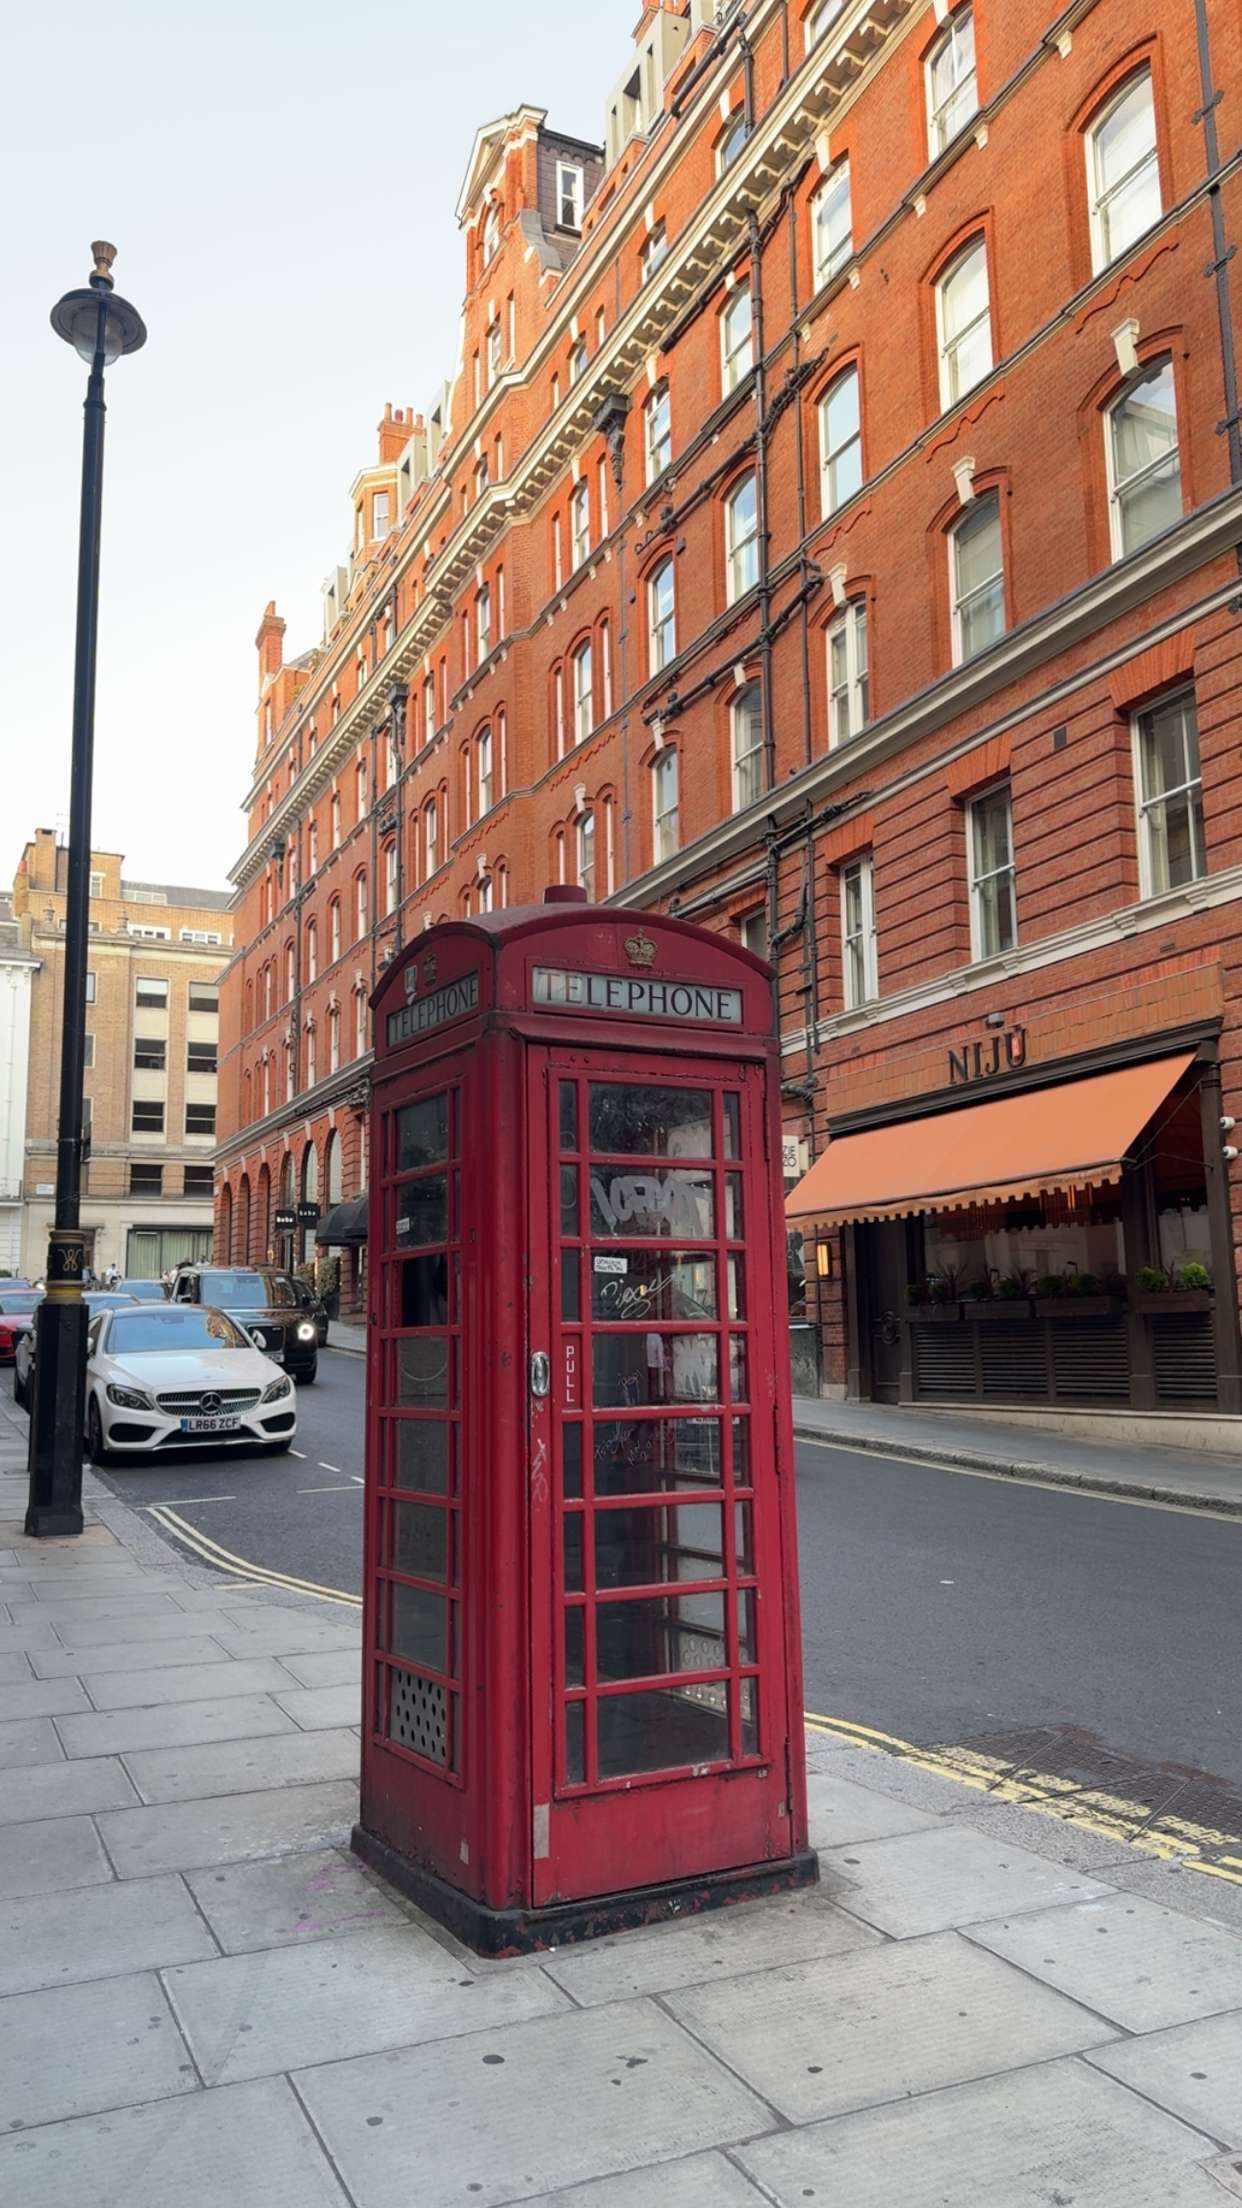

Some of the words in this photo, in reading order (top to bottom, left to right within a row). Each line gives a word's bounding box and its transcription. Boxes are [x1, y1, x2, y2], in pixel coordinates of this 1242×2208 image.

[390, 979, 479, 1041] TELEPHONE
[536, 970, 732, 1021] TELEPHONE
[566, 1345, 576, 1403] PULL
[188, 1418, 217, 1431] LR66
[218, 1416, 240, 1430] ZCF
